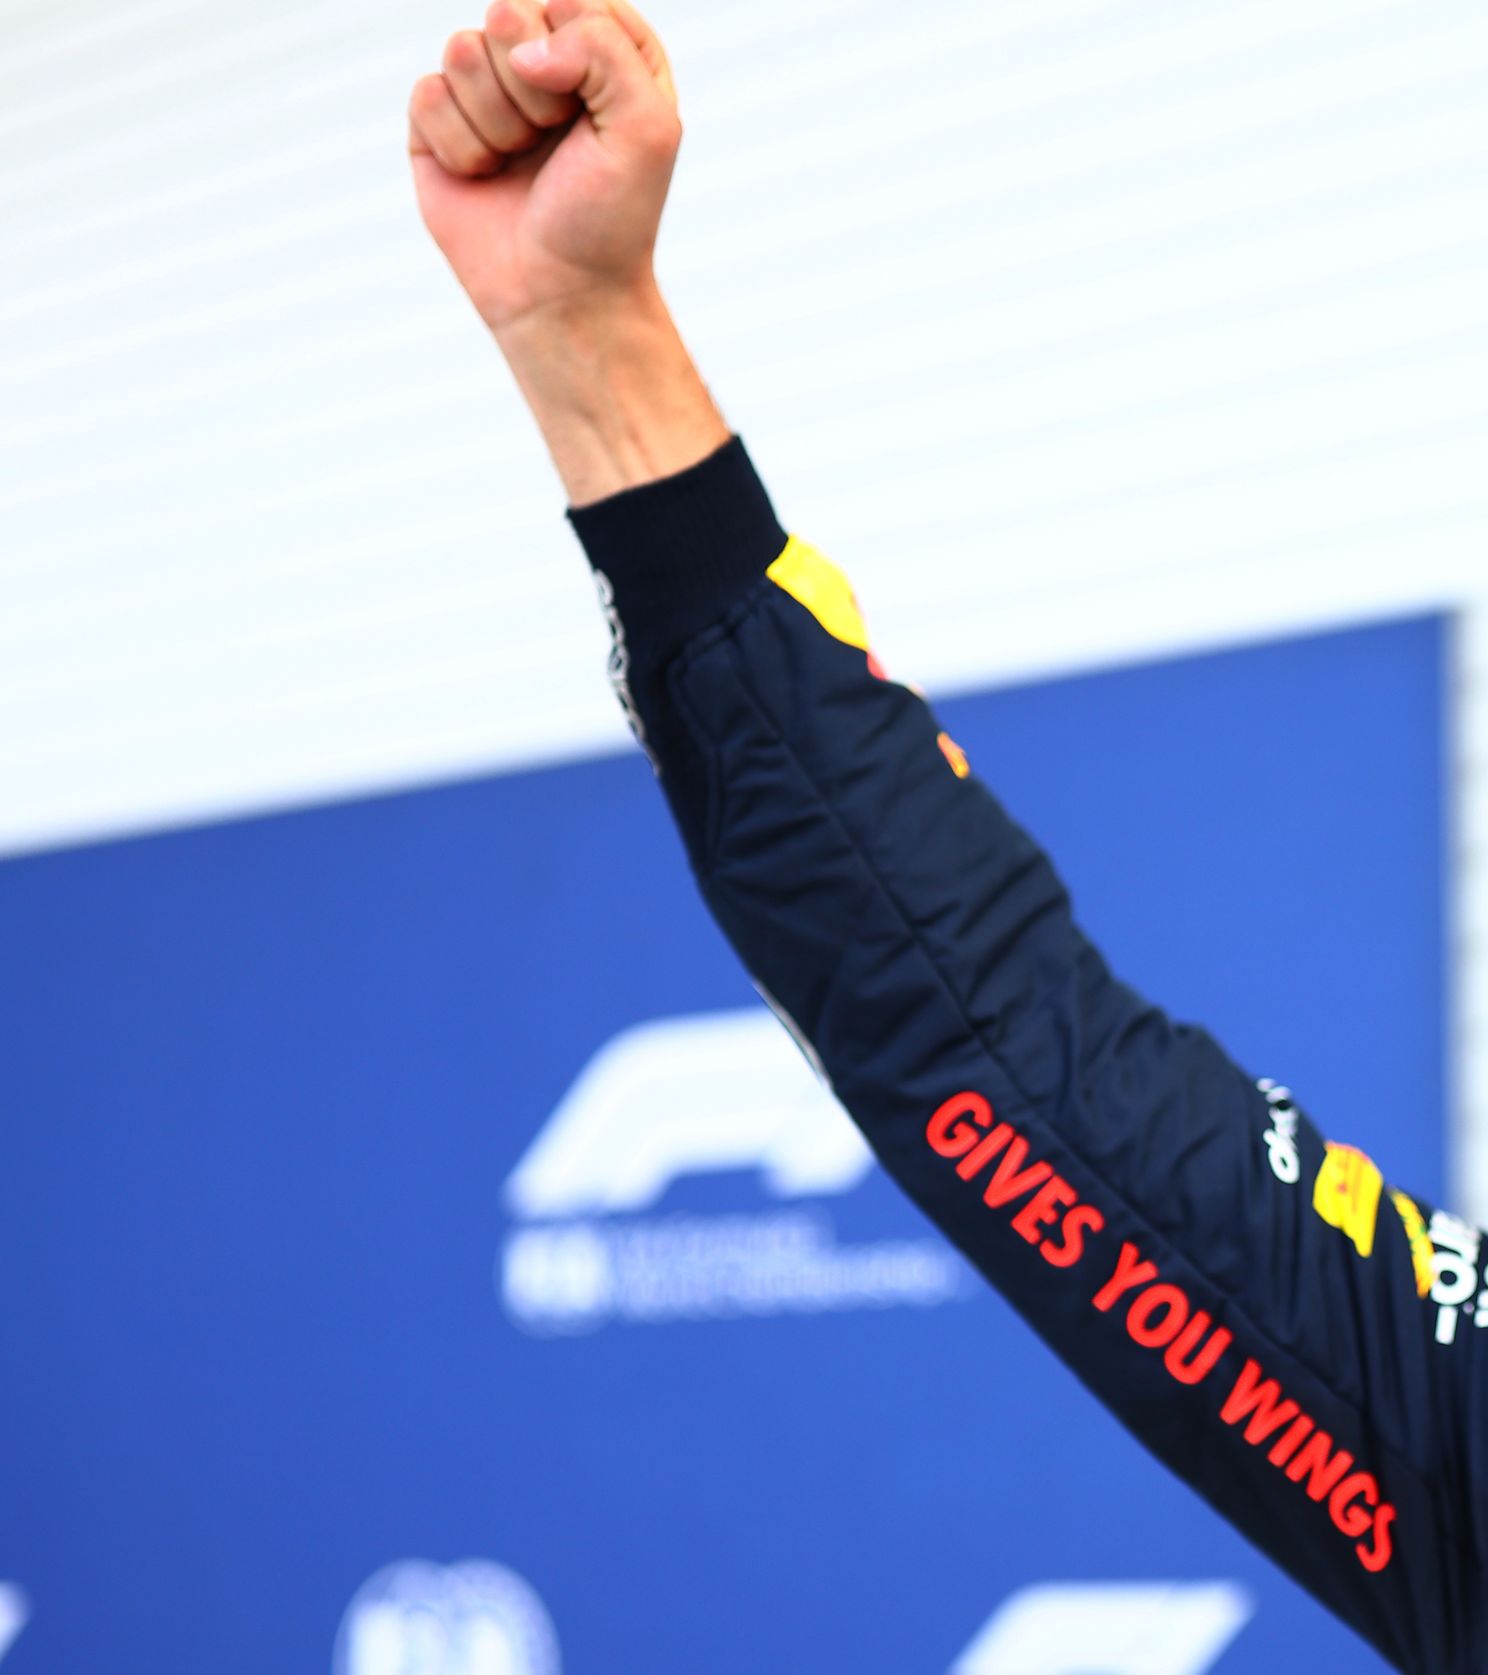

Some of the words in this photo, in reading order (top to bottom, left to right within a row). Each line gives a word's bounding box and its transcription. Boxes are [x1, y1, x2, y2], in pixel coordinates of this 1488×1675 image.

[926, 1091, 1104, 1268] GIVES
[1092, 1241, 1233, 1385] YOU
[1220, 1359, 1397, 1572] WINGS
